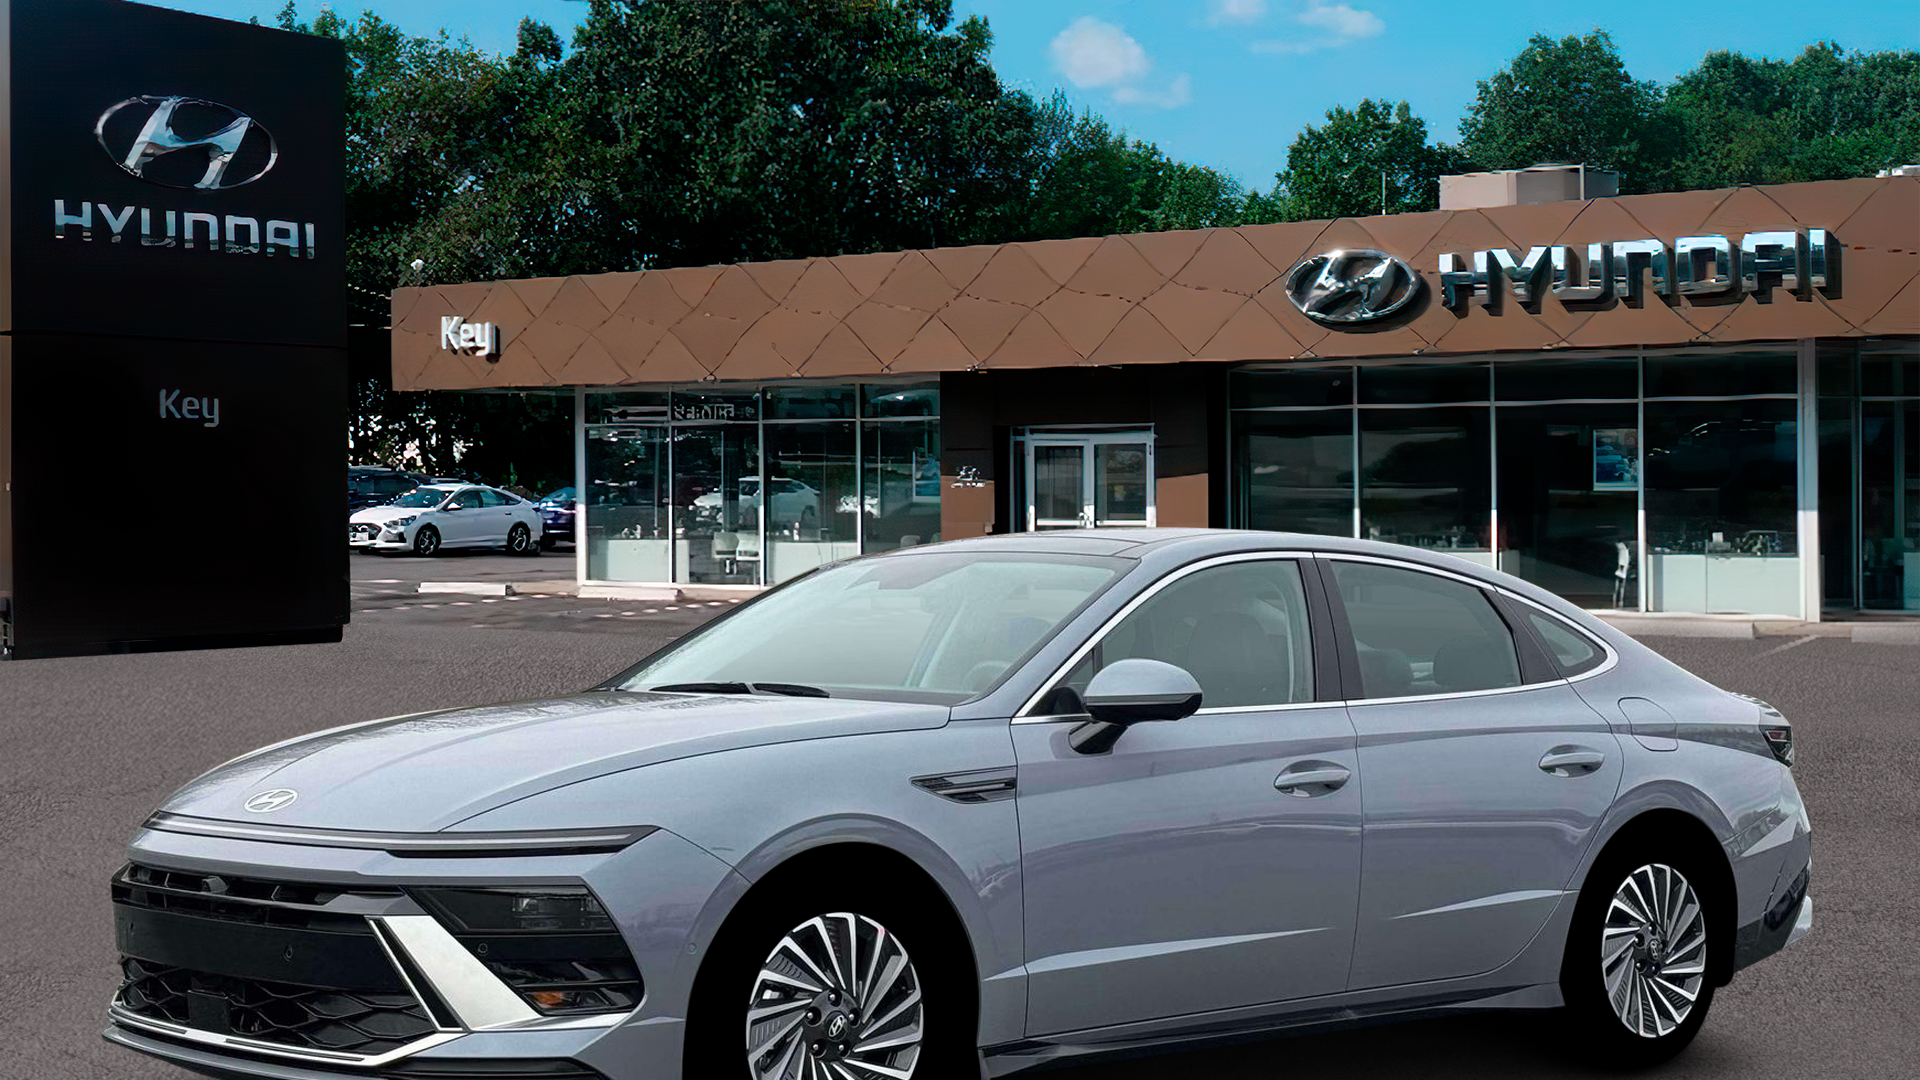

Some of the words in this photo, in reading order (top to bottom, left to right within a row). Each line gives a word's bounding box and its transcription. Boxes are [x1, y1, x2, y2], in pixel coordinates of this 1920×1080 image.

[54, 199, 316, 260] HYUNDAI
[1438, 227, 1839, 316] HYUNDAI
[440, 315, 494, 357] Key
[159, 388, 220, 427] Key
